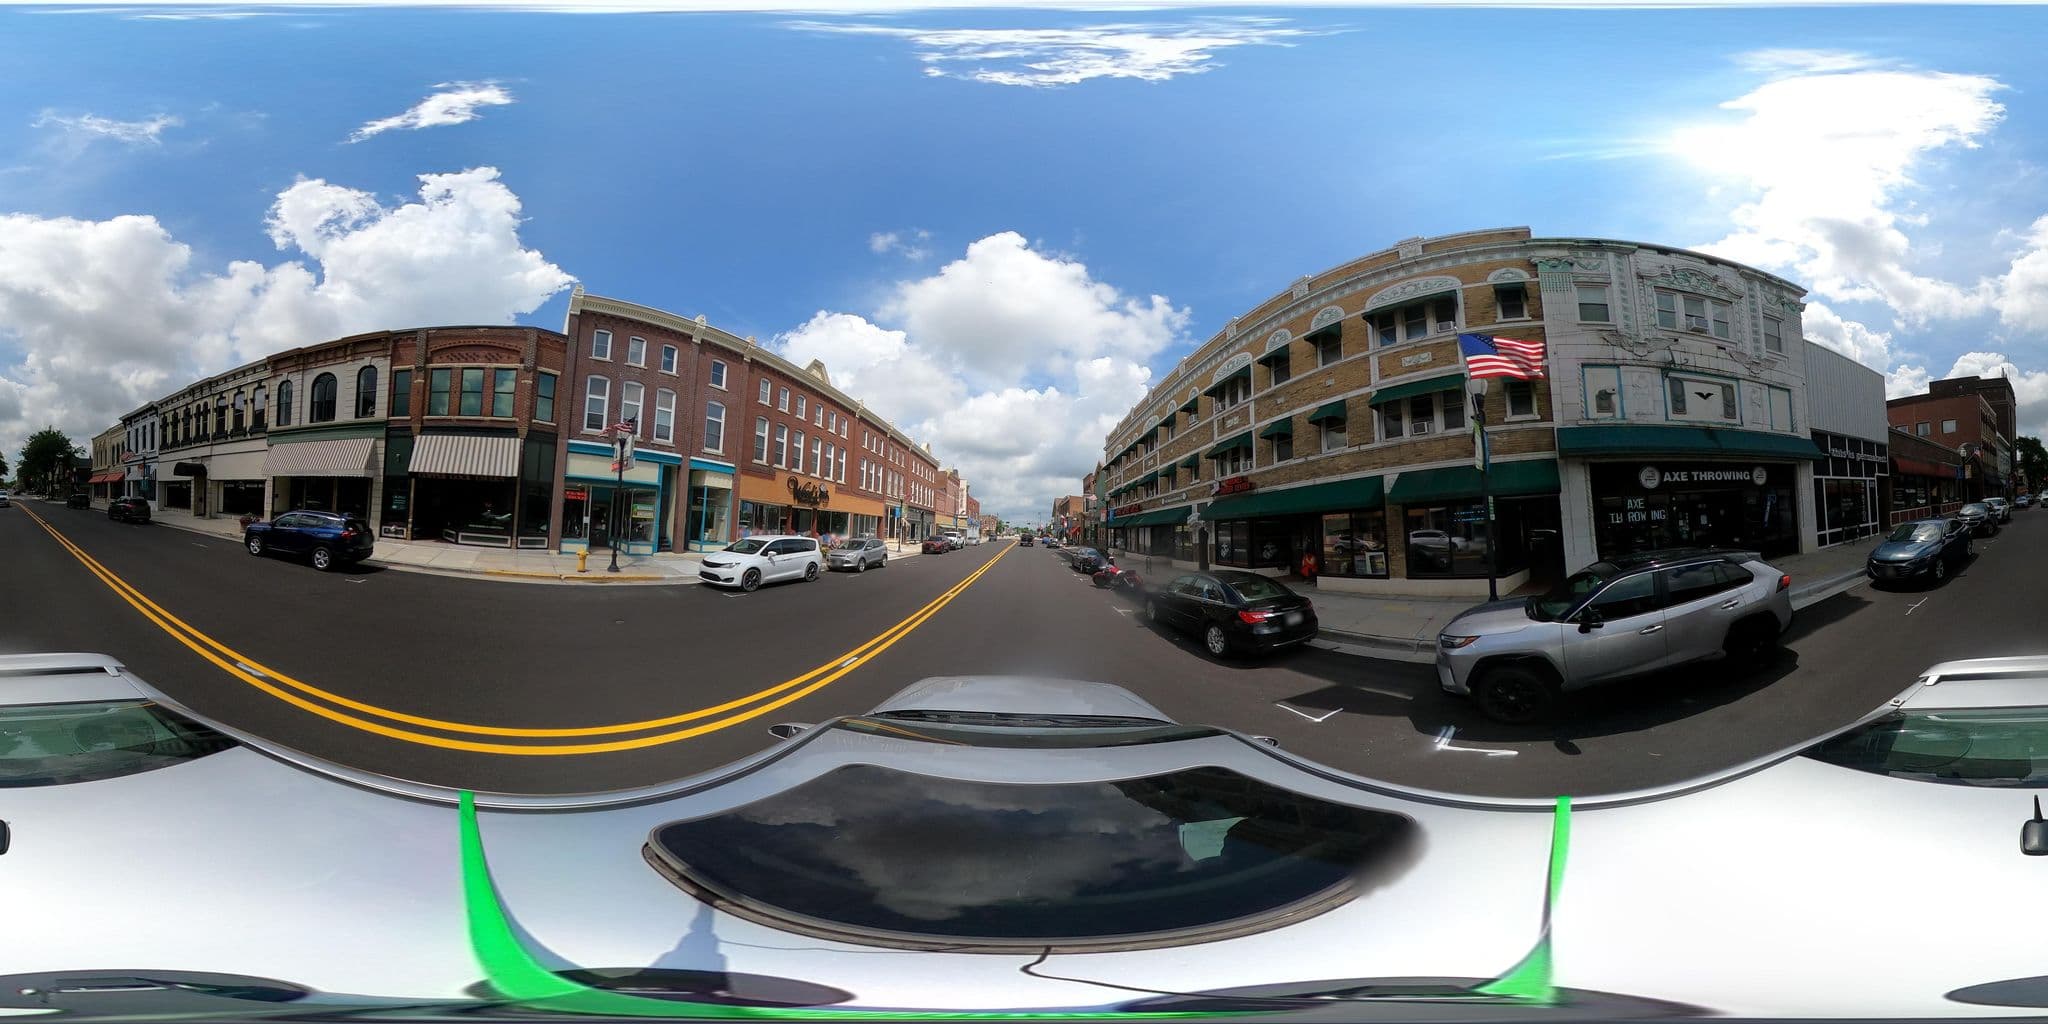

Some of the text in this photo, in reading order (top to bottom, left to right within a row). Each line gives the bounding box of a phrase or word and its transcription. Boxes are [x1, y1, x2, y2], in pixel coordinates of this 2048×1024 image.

[1663, 472, 1689, 482] AXE
[1691, 471, 1751, 481] THROWING
[1627, 498, 1646, 510] AXE
